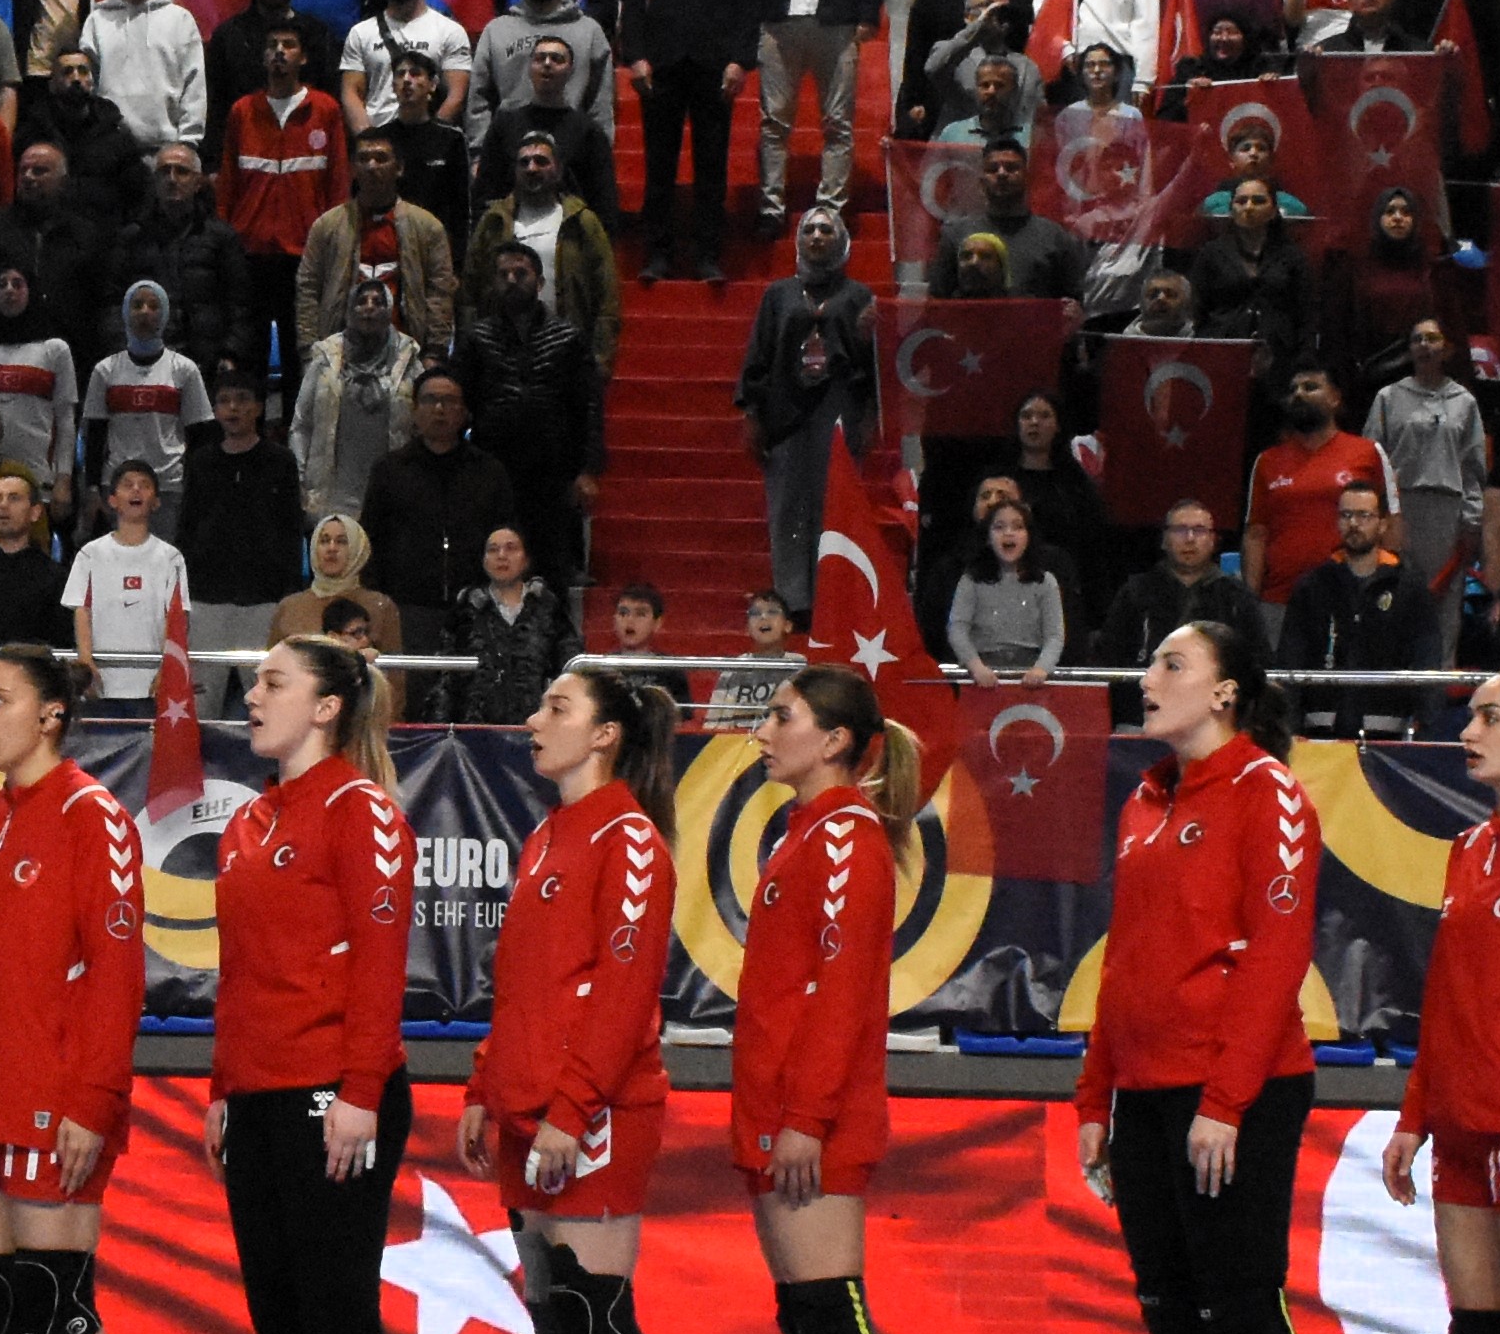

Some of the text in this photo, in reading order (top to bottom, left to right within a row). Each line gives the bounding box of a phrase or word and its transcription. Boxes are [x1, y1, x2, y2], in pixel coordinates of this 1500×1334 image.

[373, 40, 430, 52] MCLER
[192, 797, 233, 819] EHF
[414, 836, 509, 889] EURO
[433, 900, 468, 927] EHF
